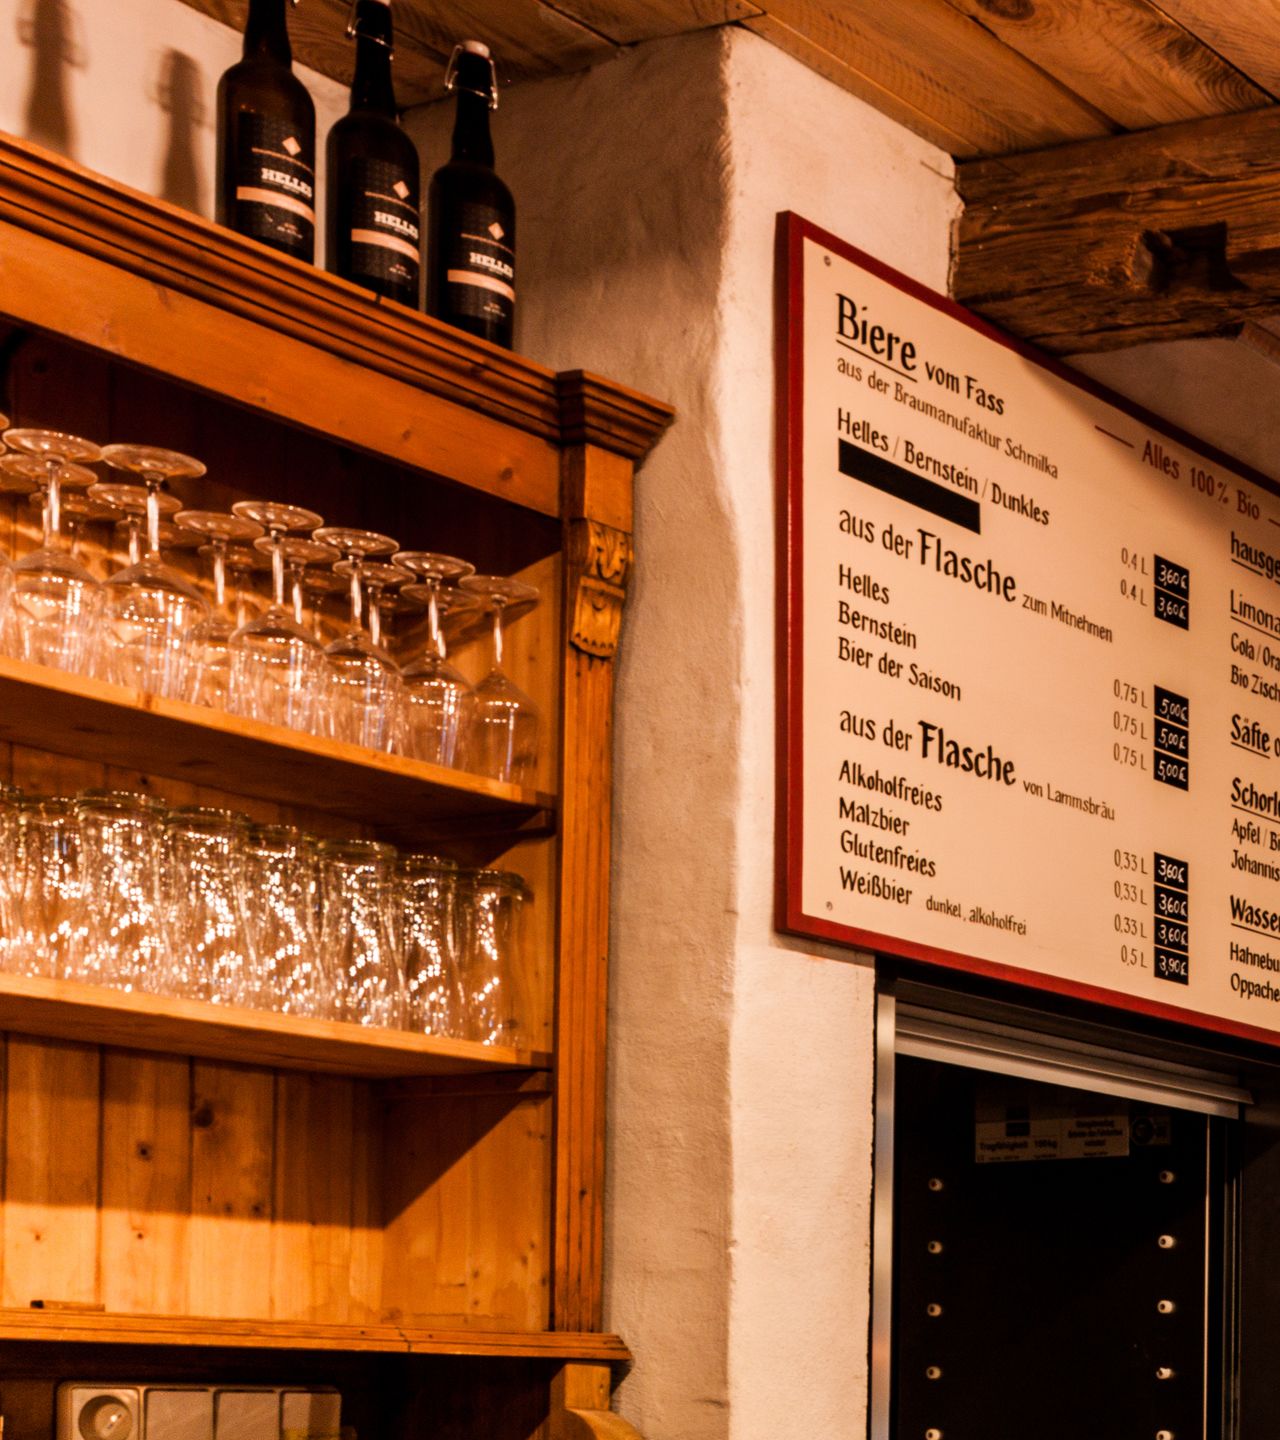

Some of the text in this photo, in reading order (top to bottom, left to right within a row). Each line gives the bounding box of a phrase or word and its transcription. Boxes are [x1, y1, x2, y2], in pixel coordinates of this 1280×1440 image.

[261, 168, 312, 198] HELLES
[374, 211, 418, 240] HELLES
[470, 252, 513, 278] HELLES
[835, 293, 1005, 416] Biere vom Fass
[837, 357, 1058, 479] aus der Braumanufaktur Schmilka
[838, 408, 1049, 526] Helles Bernstein Dunkles
[1142, 440, 1179, 480] Alles
[1237, 490, 1259, 520] Bio
[839, 510, 1112, 643] aus der Flasche zum Mitnehmen
[839, 564, 889, 604] Helles
[838, 601, 916, 649] Bernstein
[1231, 632, 1254, 660] Cola
[838, 637, 961, 701] Bier der Saison
[1231, 665, 1248, 688] Bio
[1231, 713, 1270, 752] Säfte
[838, 760, 942, 812] Alkoholfreies
[840, 711, 1115, 821] aus der Flasche von Lammsbräu
[839, 797, 909, 836] Malzbier
[1232, 819, 1260, 846] Apfel
[840, 830, 936, 877] Glutenfreies
[840, 866, 912, 905] Weißbier
[969, 908, 1026, 935] alkoholfrei
